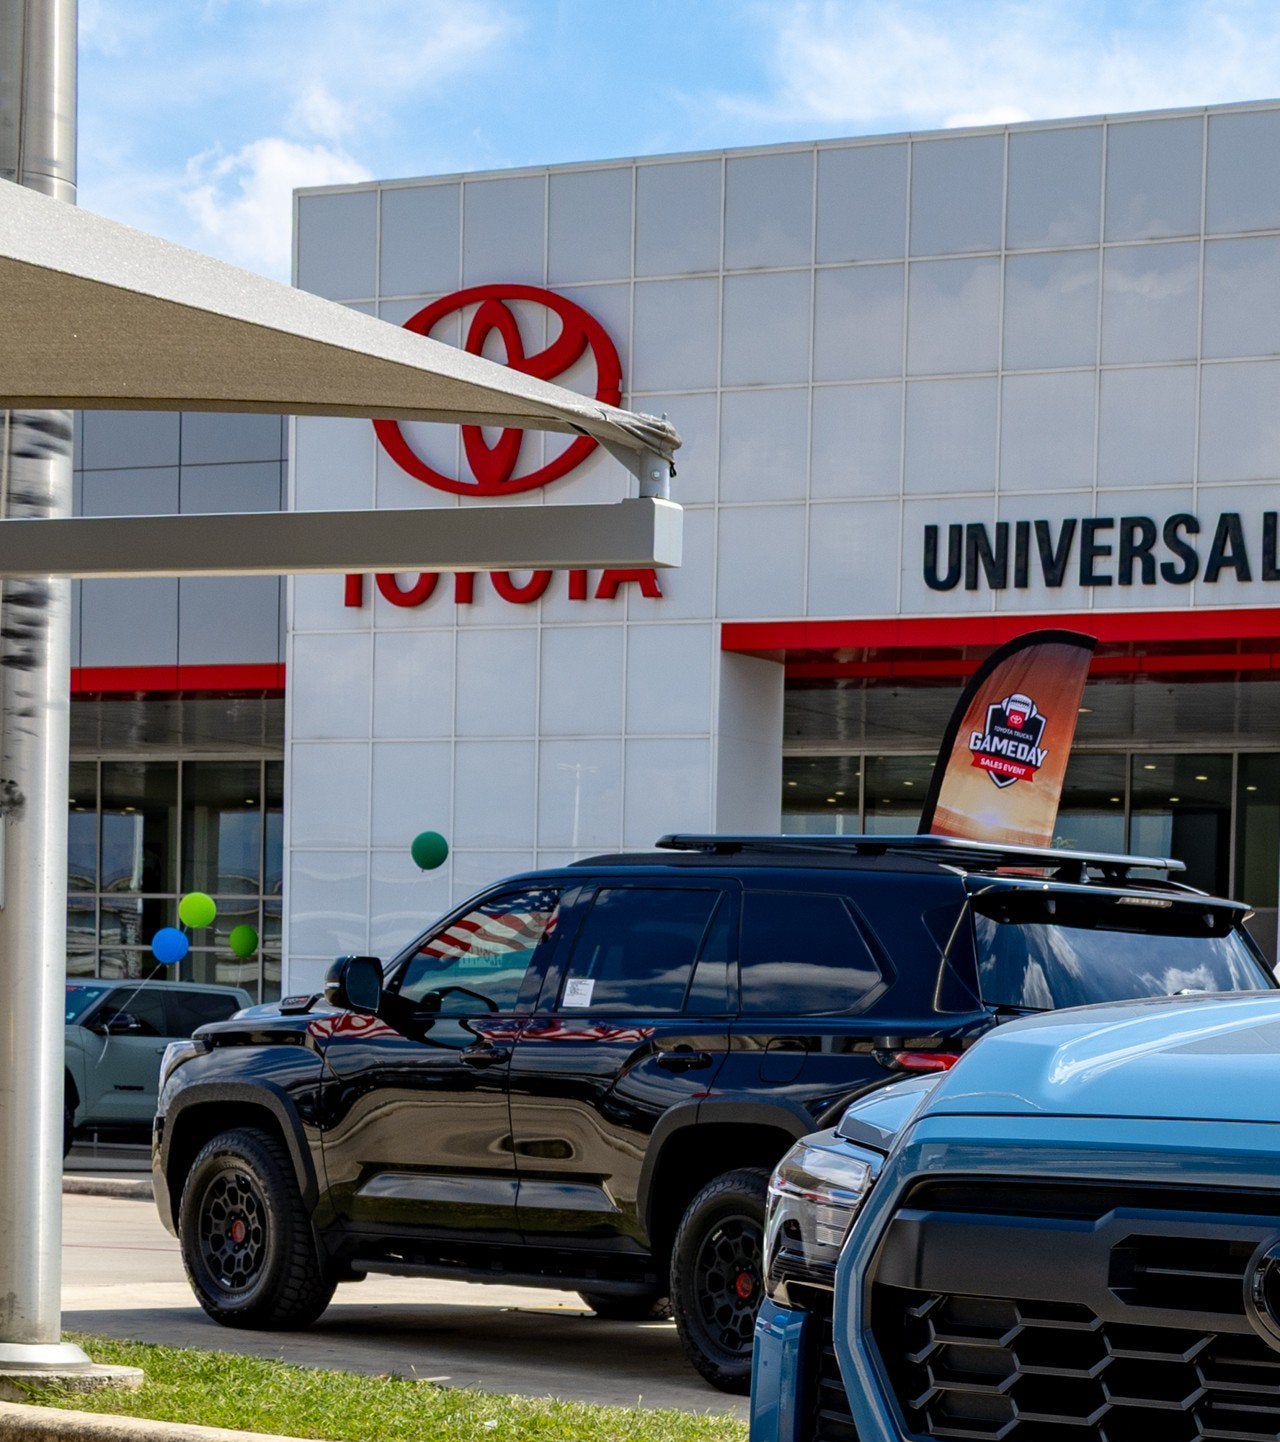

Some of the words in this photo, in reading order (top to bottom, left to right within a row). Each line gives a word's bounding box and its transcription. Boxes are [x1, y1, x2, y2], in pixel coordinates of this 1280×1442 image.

[969, 731, 1048, 767] GAMEDAY
[980, 758, 1003, 769] SALES
[1003, 763, 1026, 775] EVENT
